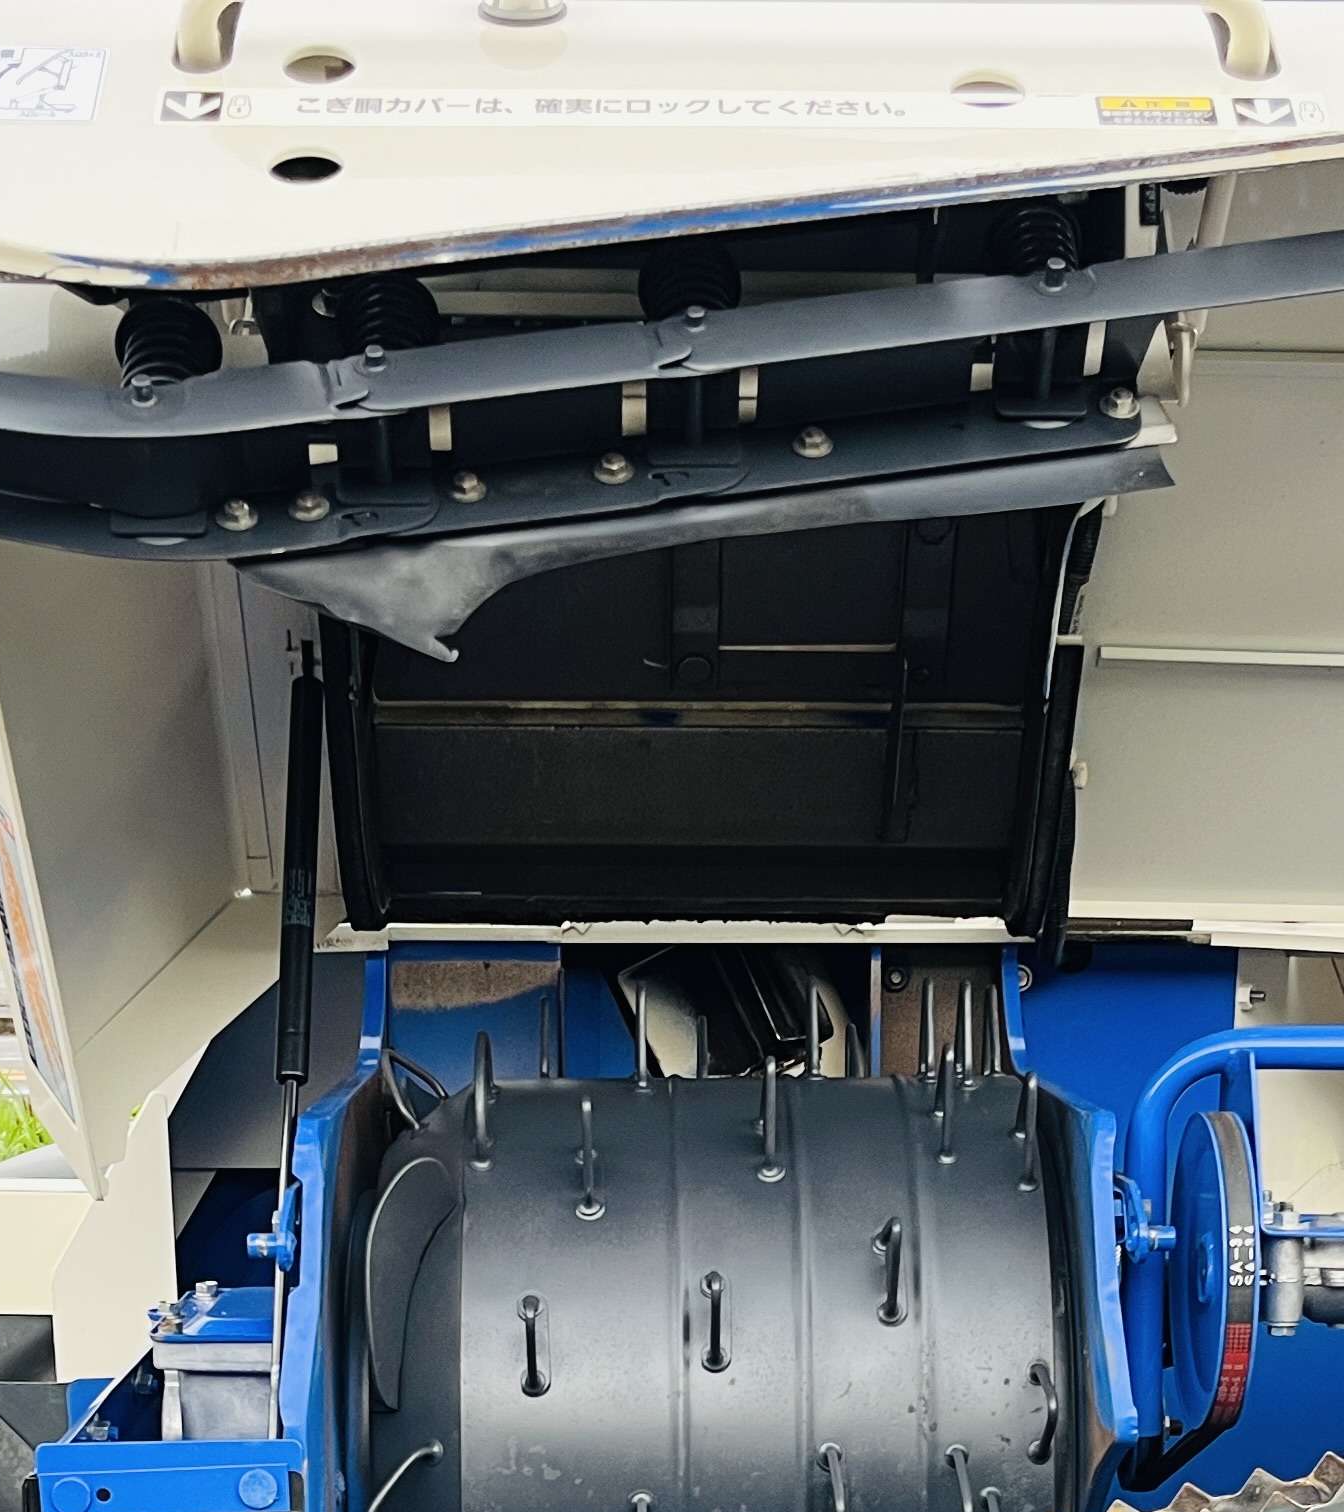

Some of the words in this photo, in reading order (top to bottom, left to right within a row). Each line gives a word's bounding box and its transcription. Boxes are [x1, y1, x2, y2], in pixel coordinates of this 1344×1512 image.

[296, 97, 906, 116] こぎ胴カバーは、確実にロックしてください。
